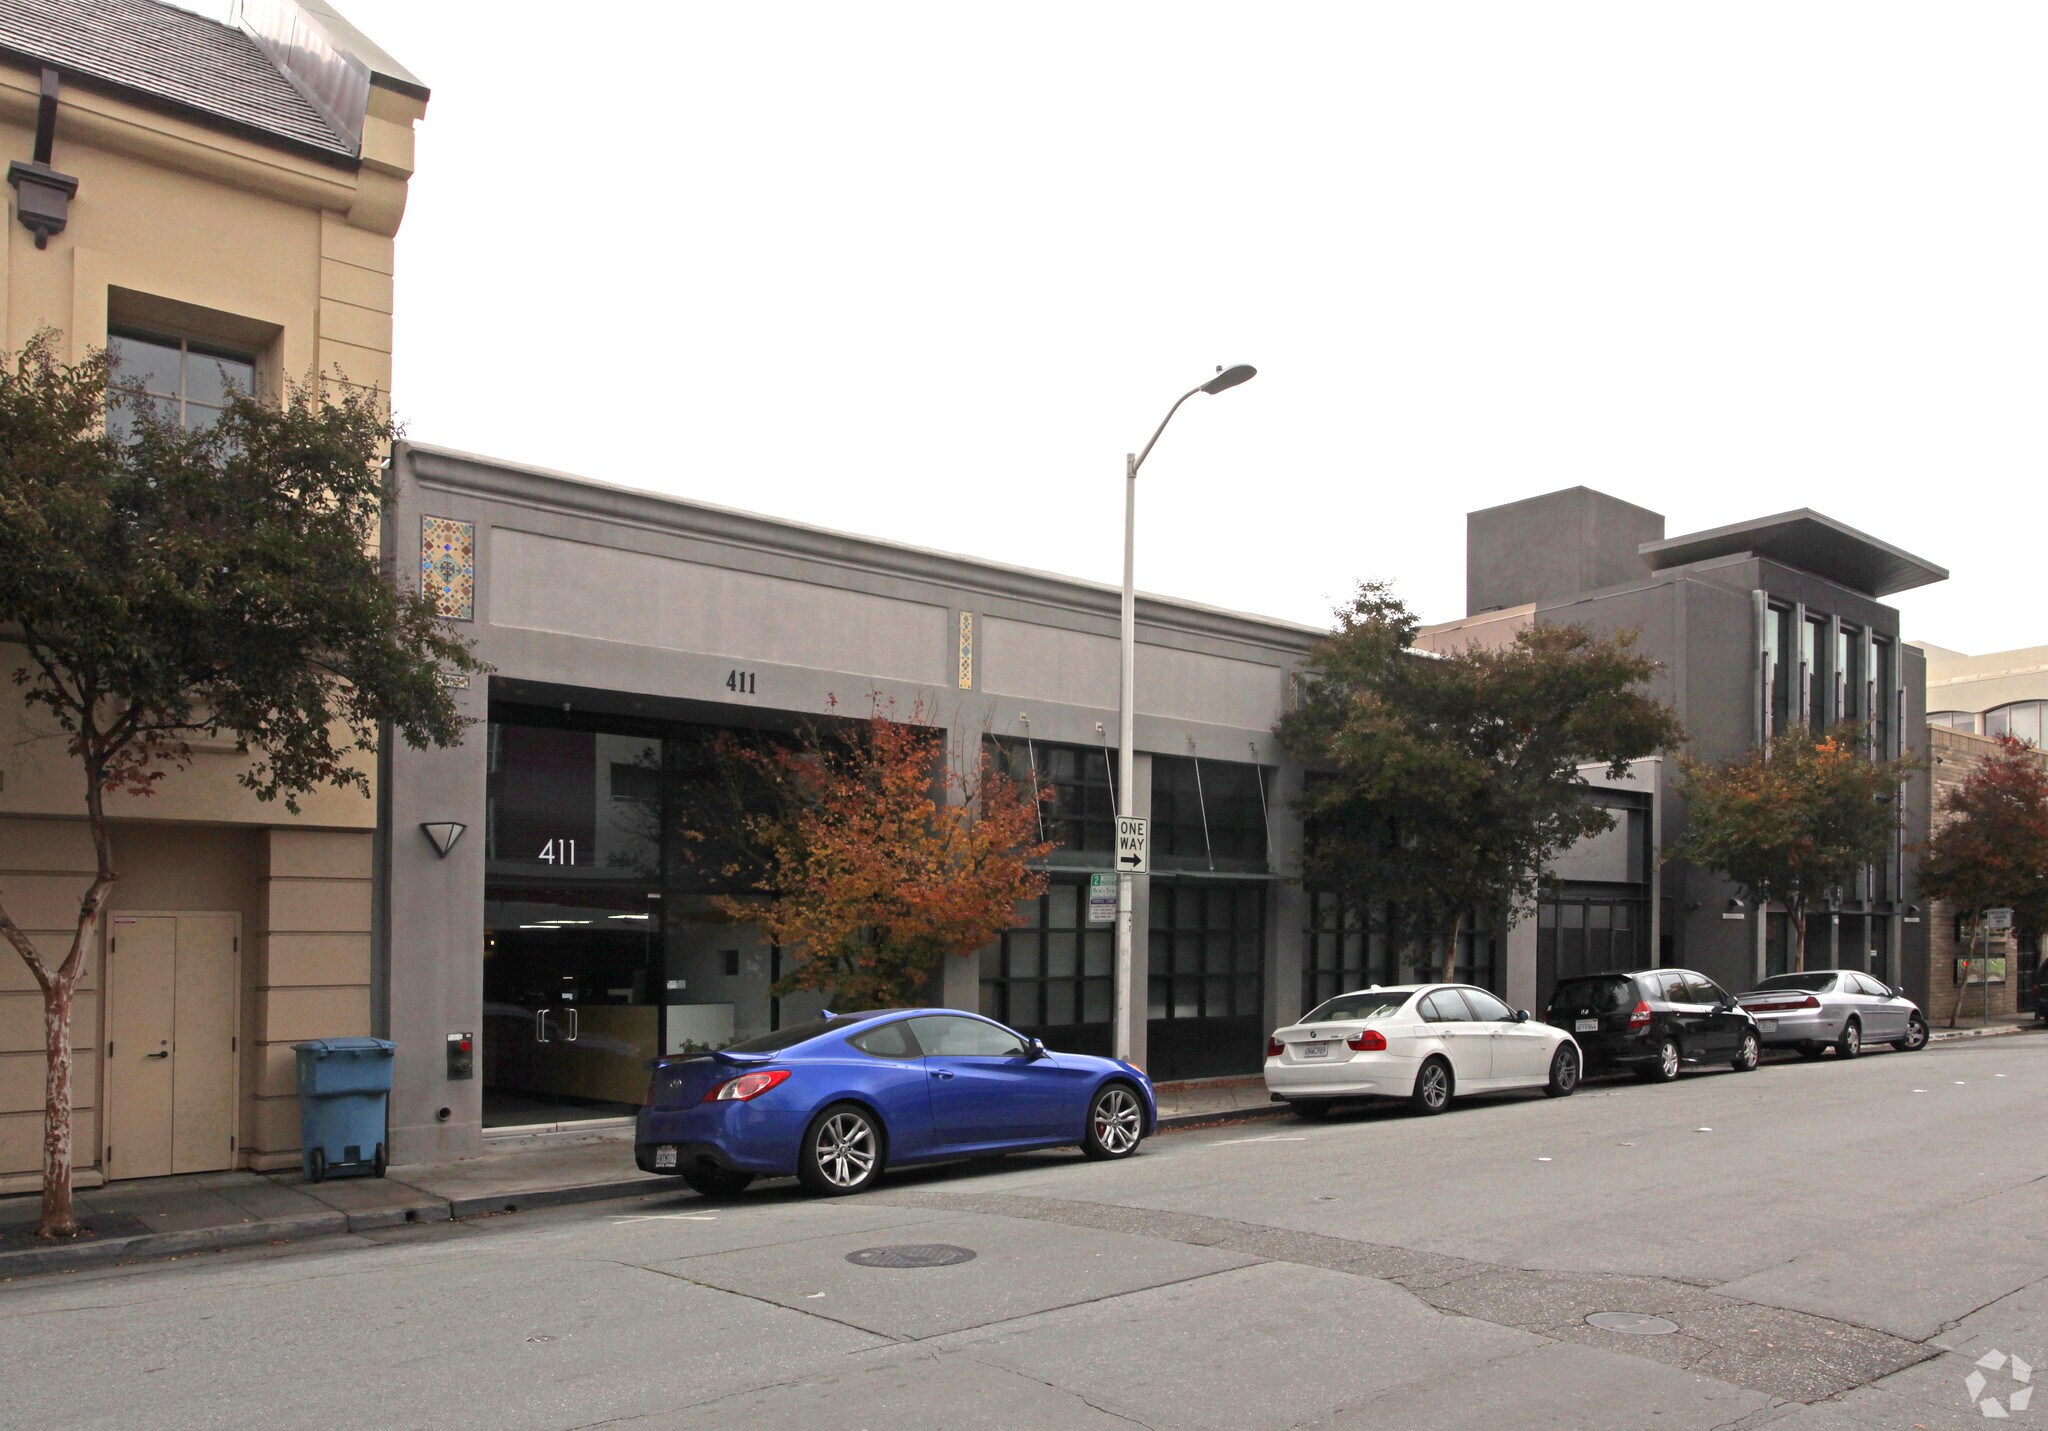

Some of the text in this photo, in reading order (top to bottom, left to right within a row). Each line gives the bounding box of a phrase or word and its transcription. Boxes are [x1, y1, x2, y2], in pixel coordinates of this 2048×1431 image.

[726, 669, 756, 694] 411
[1120, 821, 1144, 836] ONE
[1120, 837, 1145, 851] WAY
[538, 838, 575, 866] 411
[1093, 875, 1099, 886] 2
